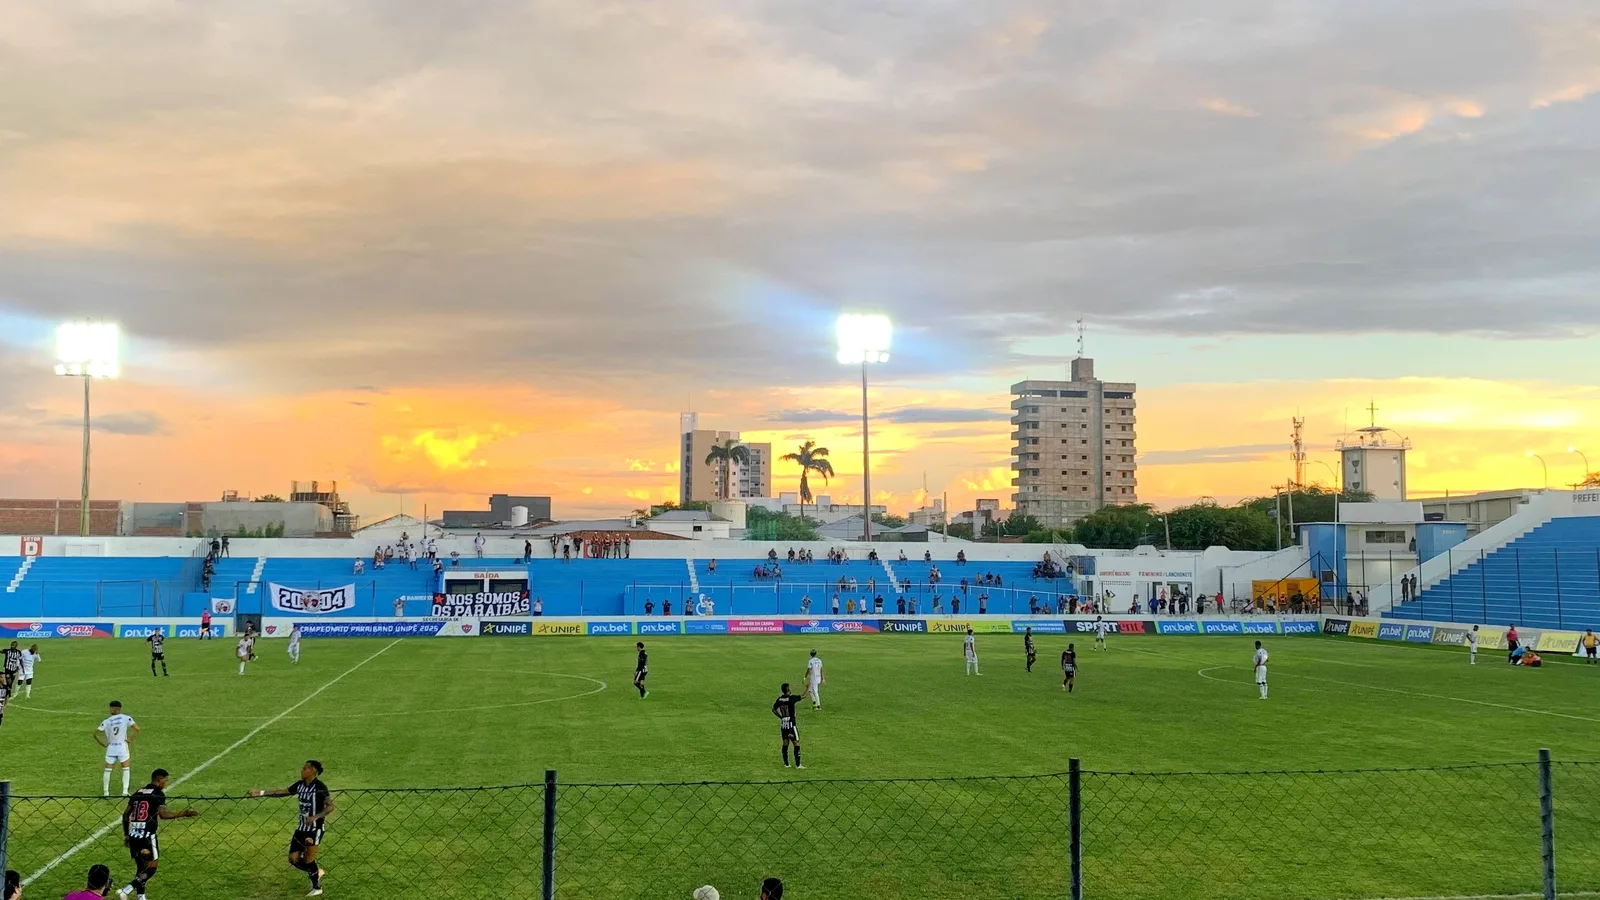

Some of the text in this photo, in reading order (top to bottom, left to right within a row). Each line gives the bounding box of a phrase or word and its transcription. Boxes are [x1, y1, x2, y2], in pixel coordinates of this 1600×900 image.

[25, 541, 38, 556] D
[474, 571, 499, 579] SAÍDA
[475, 591, 520, 605] SOMOS
[432, 604, 452, 617] OS
[300, 625, 349, 633] CAMPEONATO
[350, 625, 393, 633] PARAIBANO
[419, 625, 438, 633] 2025
[495, 623, 527, 634] UNIPÊ
[550, 624, 581, 634] UNIPÊ
[591, 623, 628, 634] pix.bet
[641, 622, 677, 634] pix.bet
[895, 621, 923, 632] UNIPÊ
[1163, 622, 1196, 633] pix.bet
[1206, 622, 1239, 633] pix.bet
[1284, 622, 1316, 633] pix.bet
[1330, 623, 1347, 633] UNIPÊ
[1443, 632, 1464, 643] UNIPÊ
